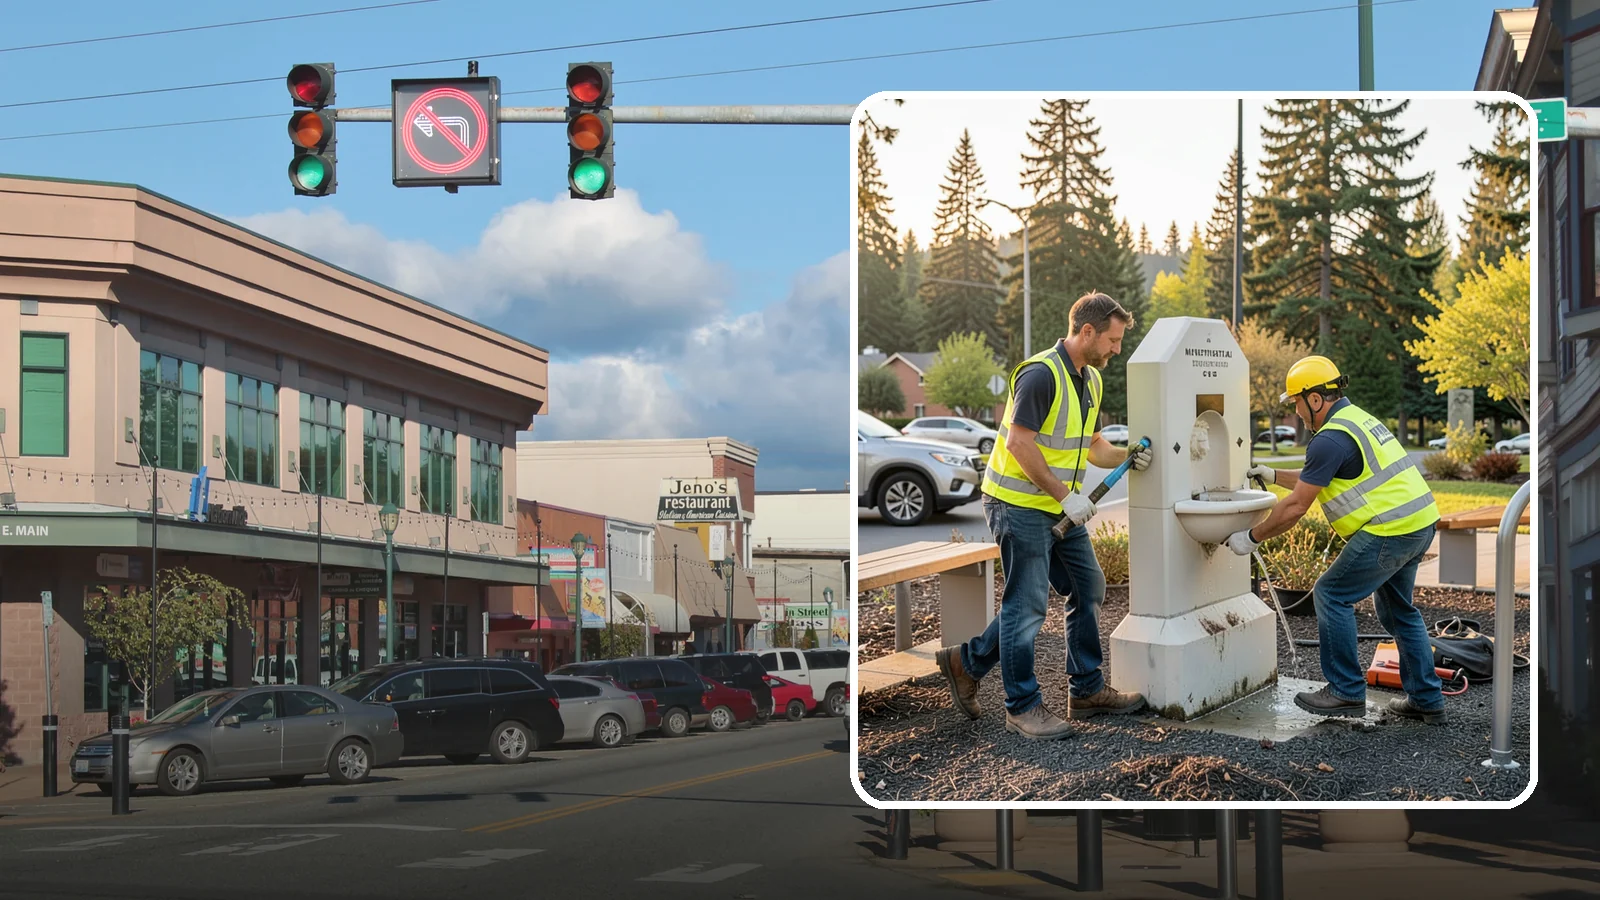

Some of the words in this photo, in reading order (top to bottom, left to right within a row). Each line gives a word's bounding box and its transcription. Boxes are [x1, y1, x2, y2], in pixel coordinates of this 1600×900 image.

[669, 479, 728, 495] Jeno's
[665, 496, 731, 509] restaurant
[658, 509, 682, 519] Italian
[686, 509, 714, 519] American
[715, 509, 737, 519] Cuisine
[2, 525, 13, 536] E.
[15, 525, 49, 536] MAIN
[797, 607, 829, 617] Street
